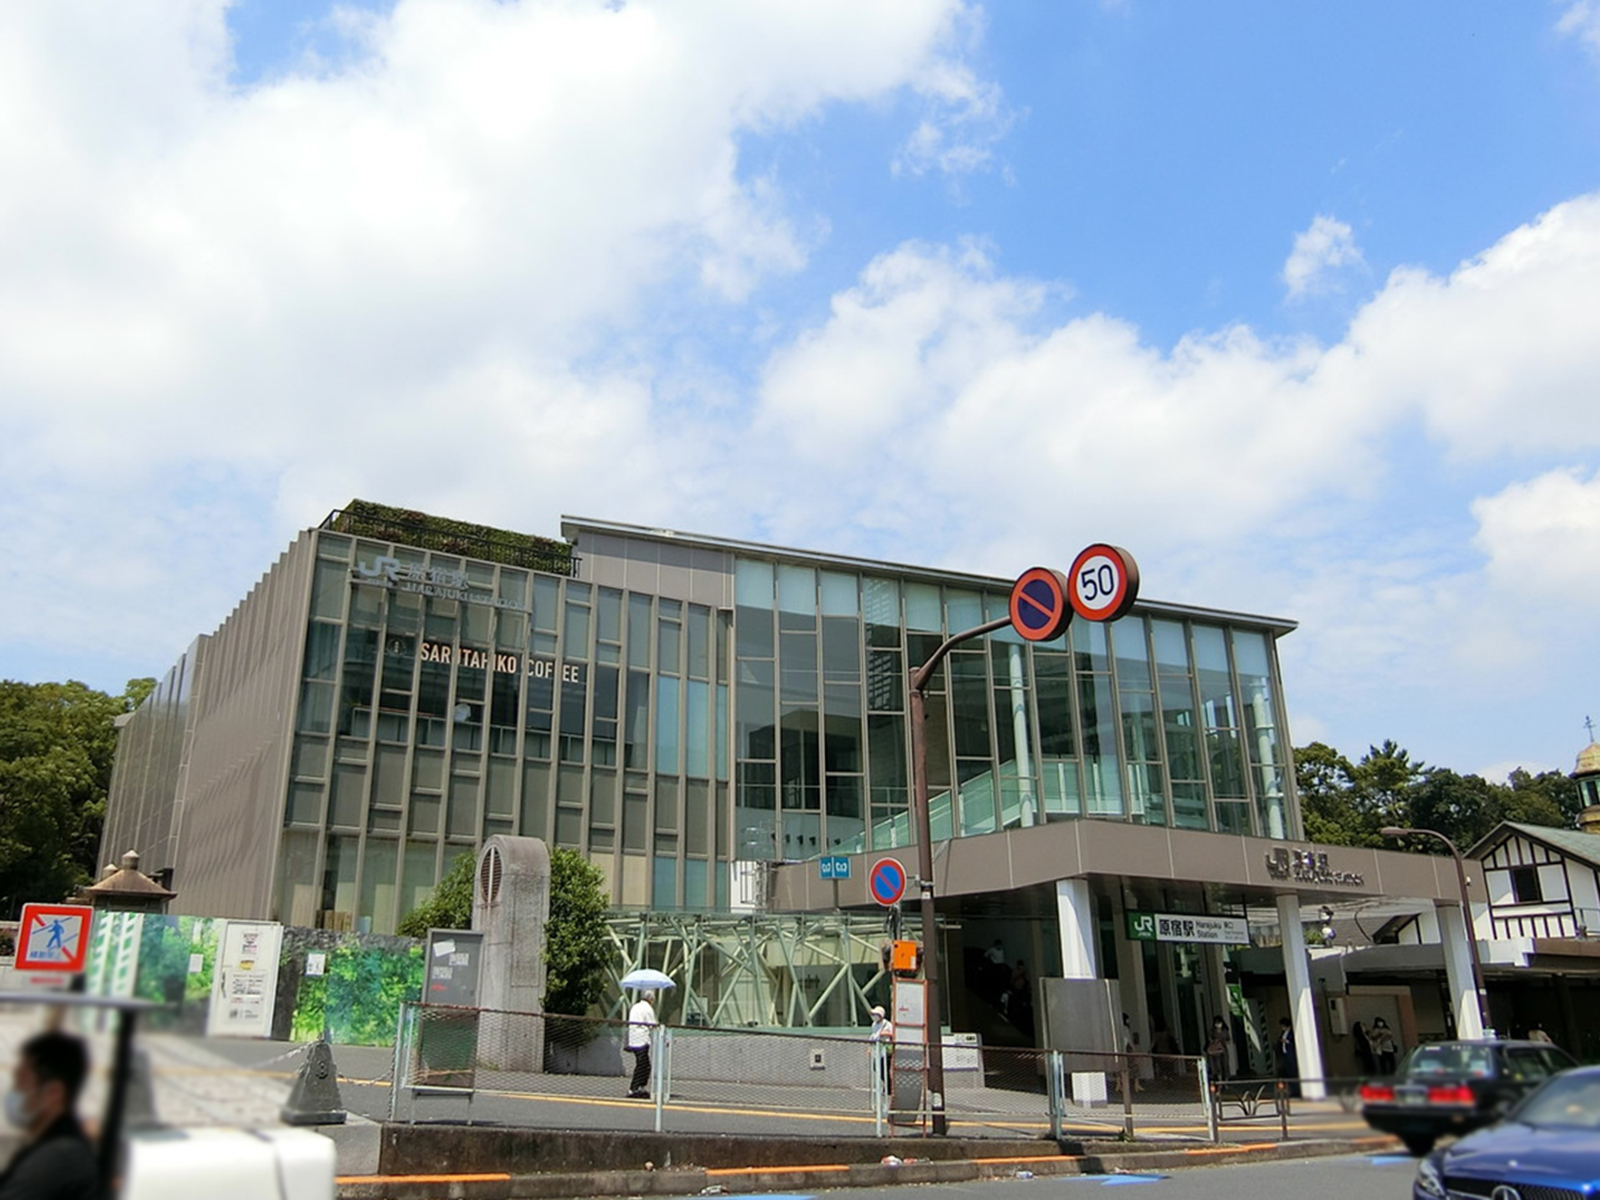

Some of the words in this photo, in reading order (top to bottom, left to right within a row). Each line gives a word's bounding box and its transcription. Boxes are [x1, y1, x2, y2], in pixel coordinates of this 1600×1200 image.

[358, 555, 400, 581] JR
[1081, 564, 1114, 601] 50
[527, 659, 579, 683] COFEE
[1134, 916, 1153, 932] JR
[1159, 919, 1195, 937] 原宿駅
